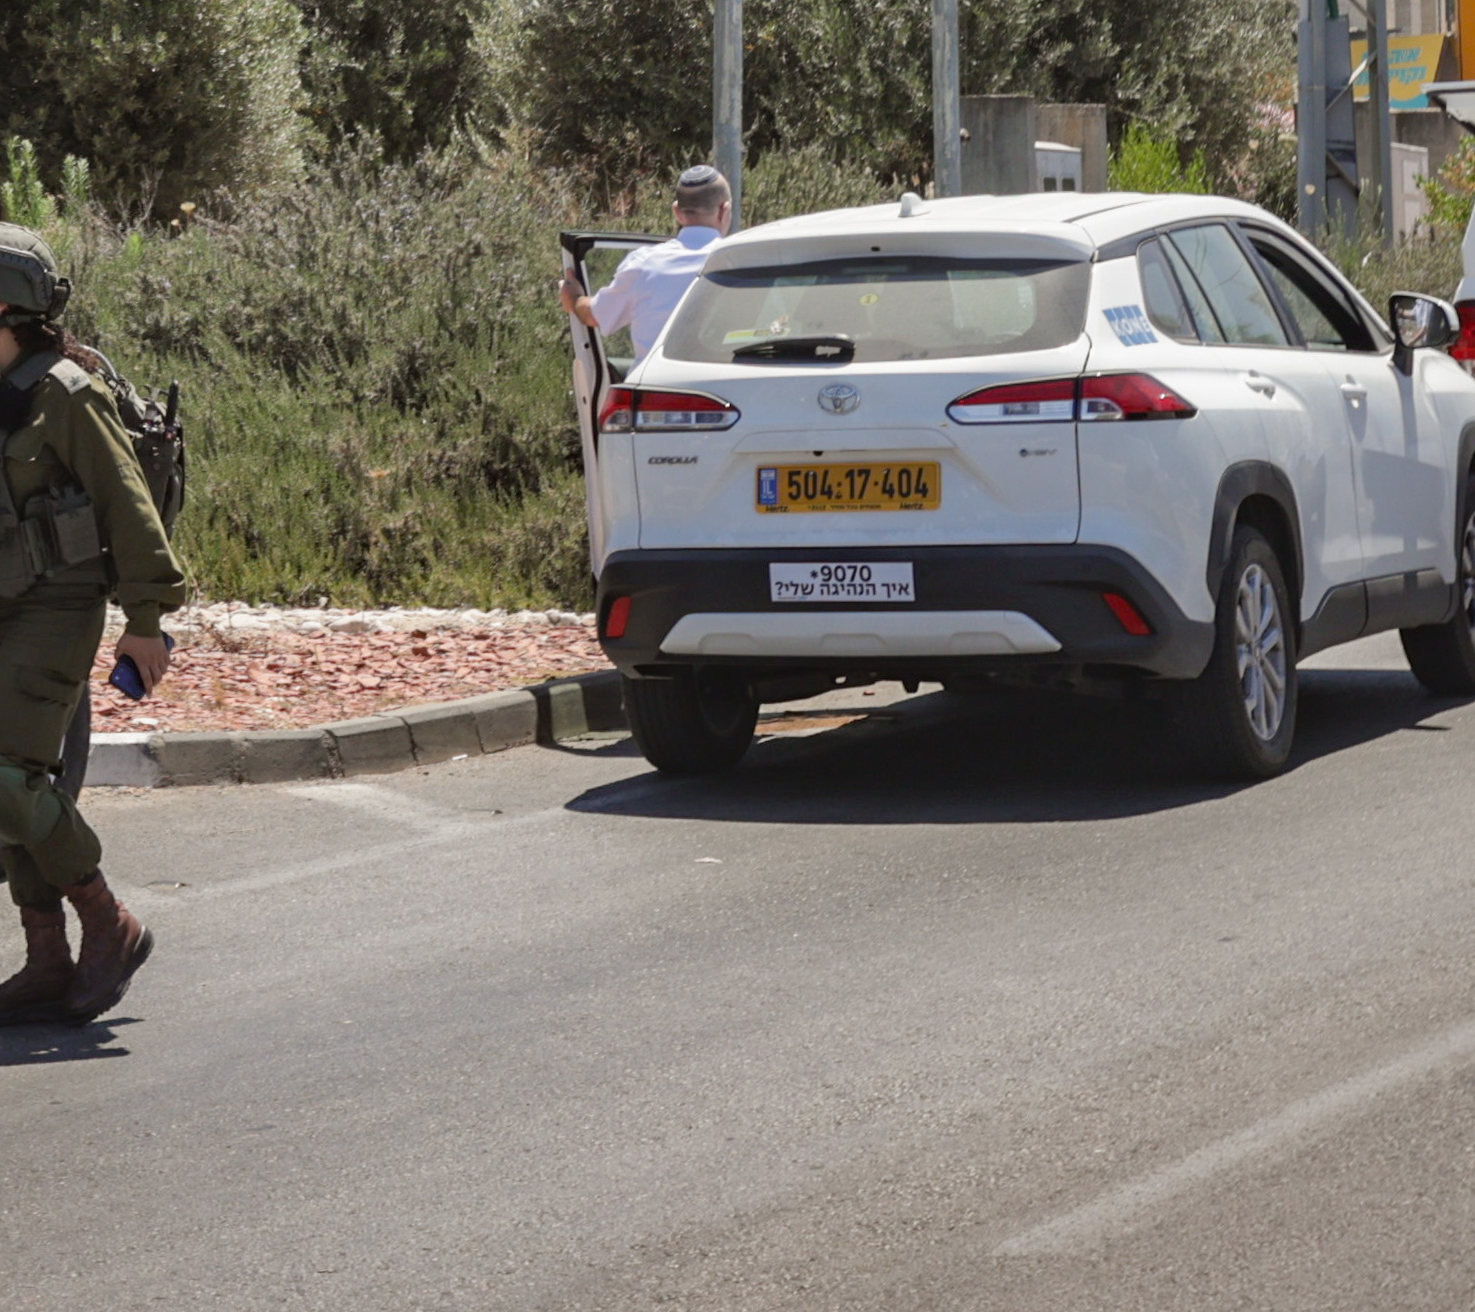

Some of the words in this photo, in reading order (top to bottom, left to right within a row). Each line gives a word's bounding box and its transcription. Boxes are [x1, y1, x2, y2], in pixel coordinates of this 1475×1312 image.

[775, 581, 814, 596] שלי?
[820, 583, 877, 596] הנהיגה
[881, 583, 910, 598] איך
